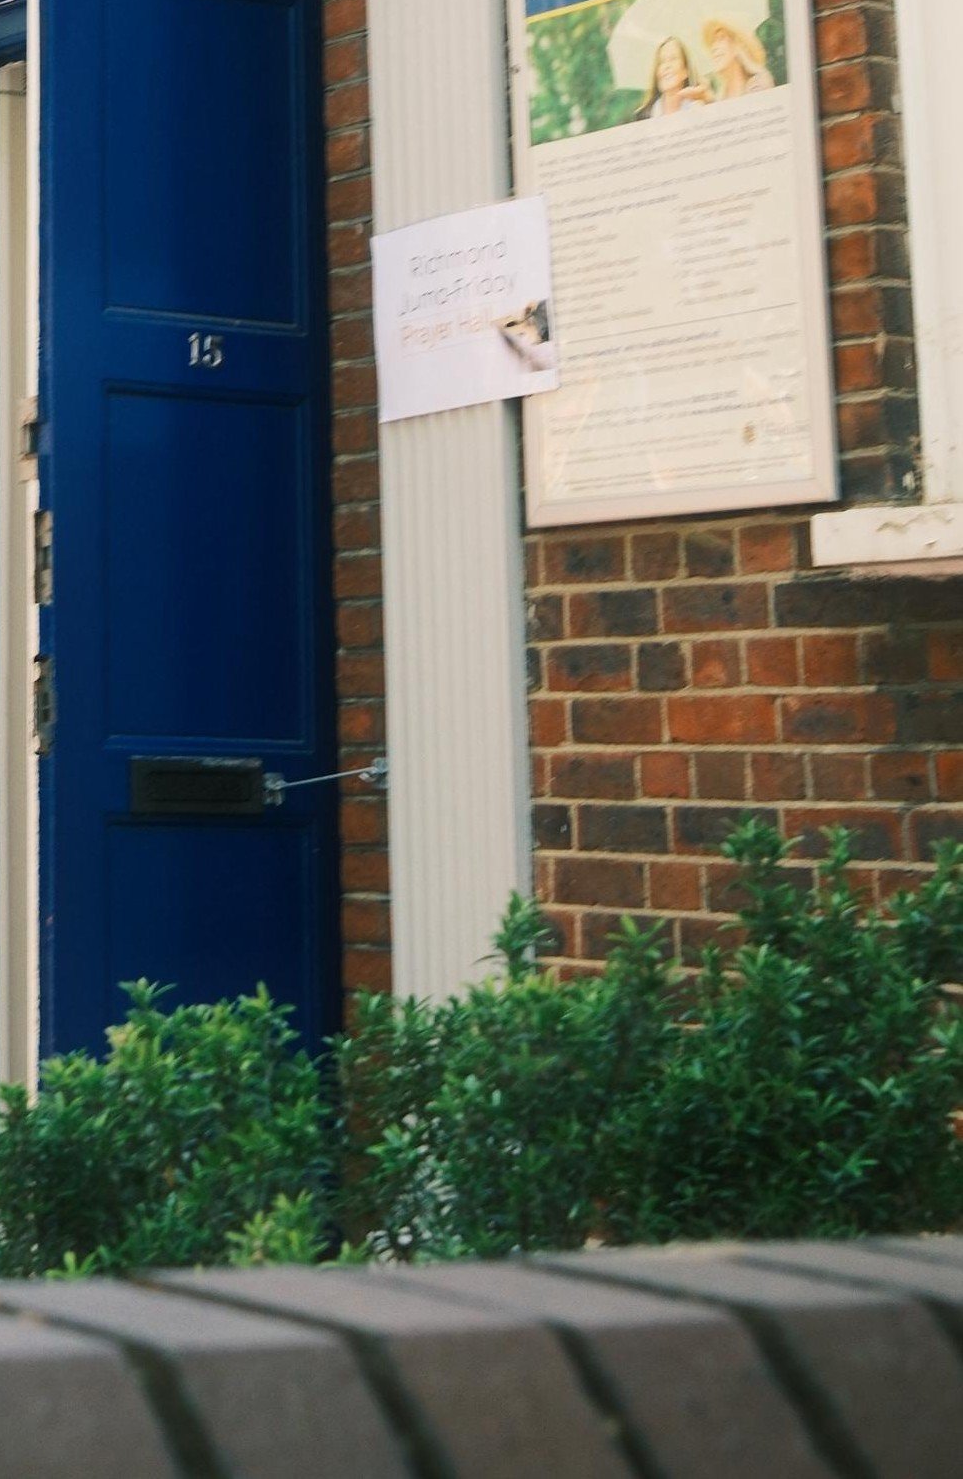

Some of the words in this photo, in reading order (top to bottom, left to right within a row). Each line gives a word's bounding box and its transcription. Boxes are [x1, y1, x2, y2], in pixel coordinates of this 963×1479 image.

[408, 235, 507, 276] Richmond
[401, 320, 453, 350] Prayer
[457, 306, 492, 334] Hall
[187, 331, 224, 368] 15
